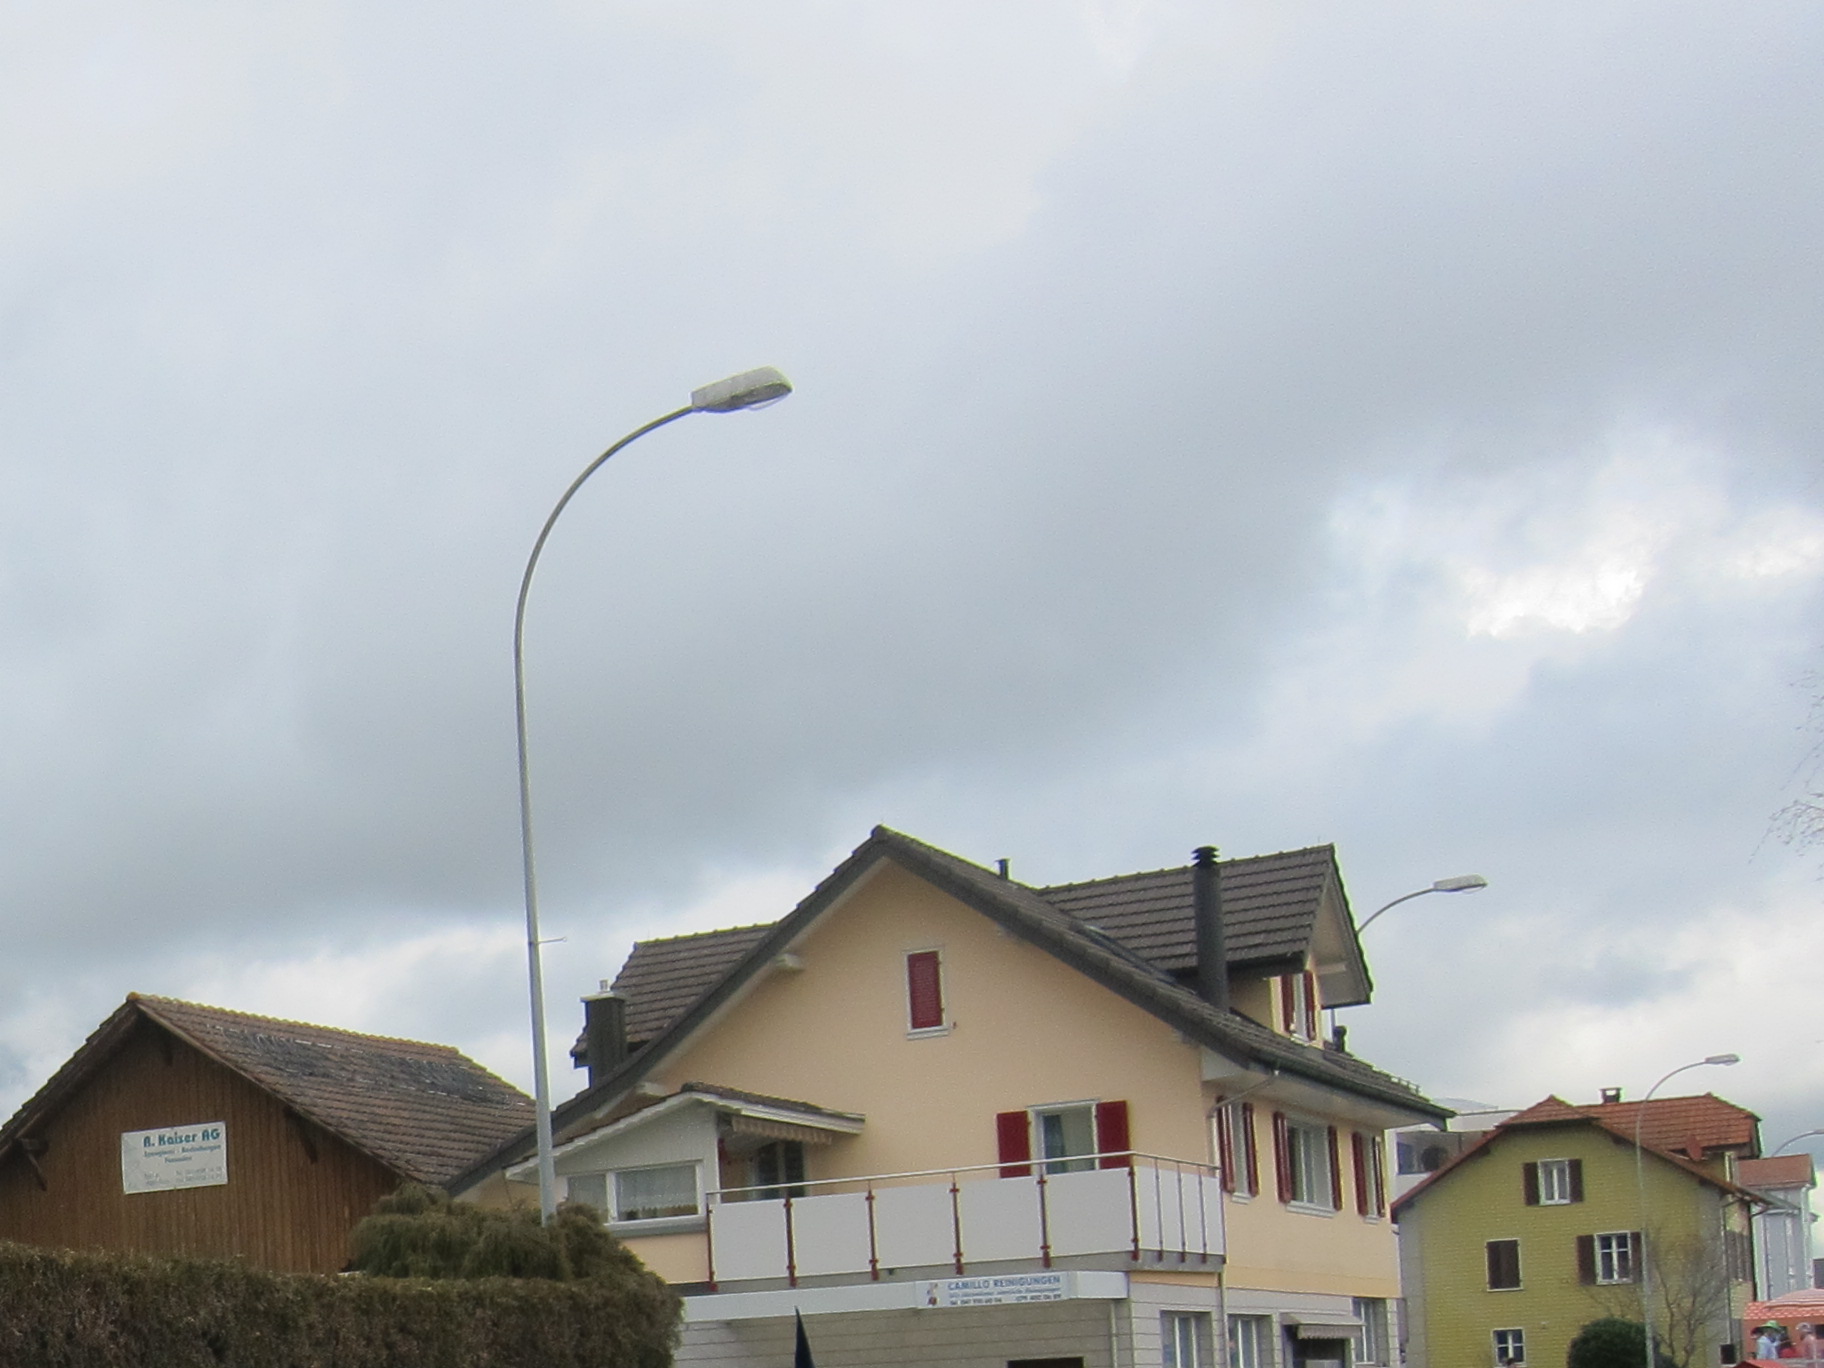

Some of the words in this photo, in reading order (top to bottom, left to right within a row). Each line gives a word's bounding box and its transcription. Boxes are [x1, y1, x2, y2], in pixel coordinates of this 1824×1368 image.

[158, 1131, 198, 1147] Kaiser
[202, 1128, 221, 1142] AG
[947, 1280, 990, 1291] CAMILLO
[993, 1274, 1061, 1288] REINIGUNGEN
